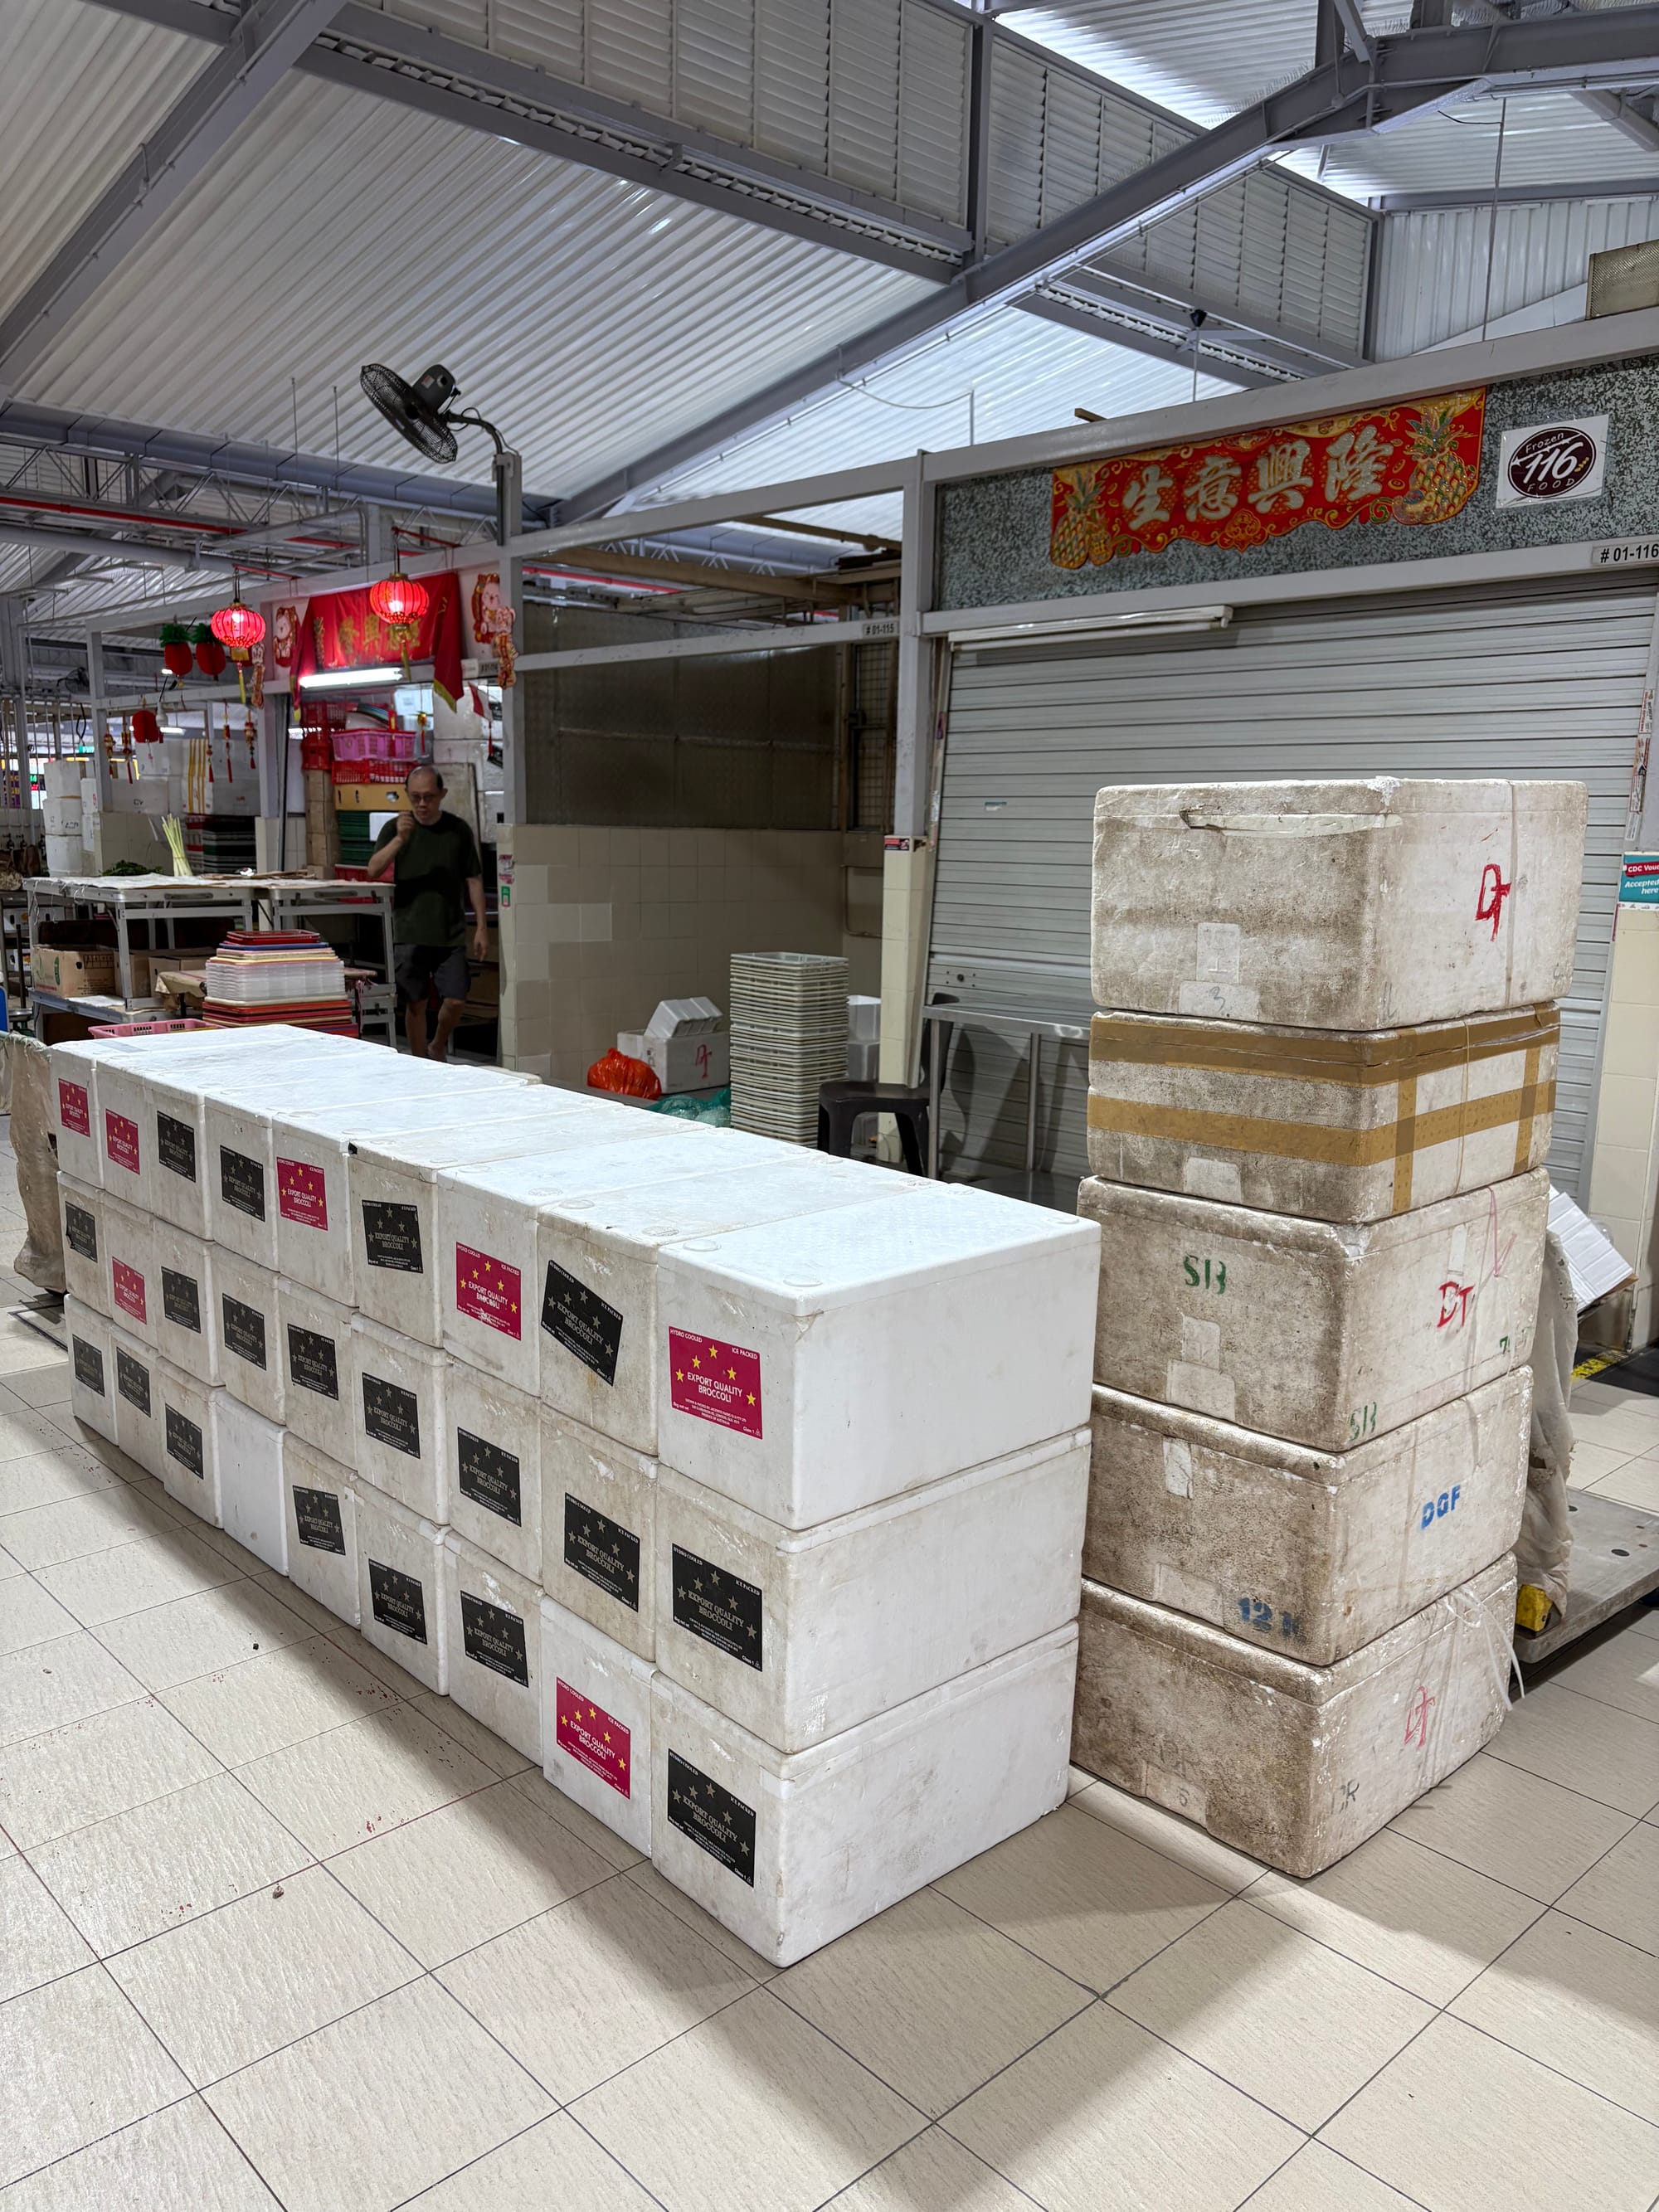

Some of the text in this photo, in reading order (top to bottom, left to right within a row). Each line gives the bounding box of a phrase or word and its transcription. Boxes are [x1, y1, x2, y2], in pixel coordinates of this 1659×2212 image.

[1525, 432, 1564, 454] Frozen
[1522, 442, 1584, 484] 116
[1121, 424, 1394, 531] 生意興隆
[1527, 479, 1575, 493] FOOD
[1600, 543, 1659, 563] # 01-116
[469, 1281, 508, 1305] EXPORT QUALITY
[557, 1301, 603, 1345] EXPORT QUALITY
[564, 1316, 592, 1345] BROCCOLI
[670, 1329, 702, 1343] HYDRO COOLED
[740, 1349, 757, 1360] PACKED
[688, 1372, 742, 1398] EXPORT QUALITY
[698, 1385, 732, 1403] BROCCOLI
[577, 1534, 624, 1573] EXPORT QUALITY
[586, 1549, 614, 1574] BROCCOLI
[743, 1583, 760, 1597] PACKED
[688, 1590, 744, 1629] EXPORT QUALITY
[698, 1605, 732, 1631] BROCCOLI
[571, 1720, 615, 1760] EXPORT QUALITY
[615, 1720, 629, 1734] PACKED
[580, 1734, 606, 1761] BROCCOLI
[683, 1794, 707, 1820] EXPORT
[708, 1814, 737, 1844] QUALITY
[737, 1801, 754, 1817] PACKED
[693, 1811, 726, 1843] BROCCOLI
